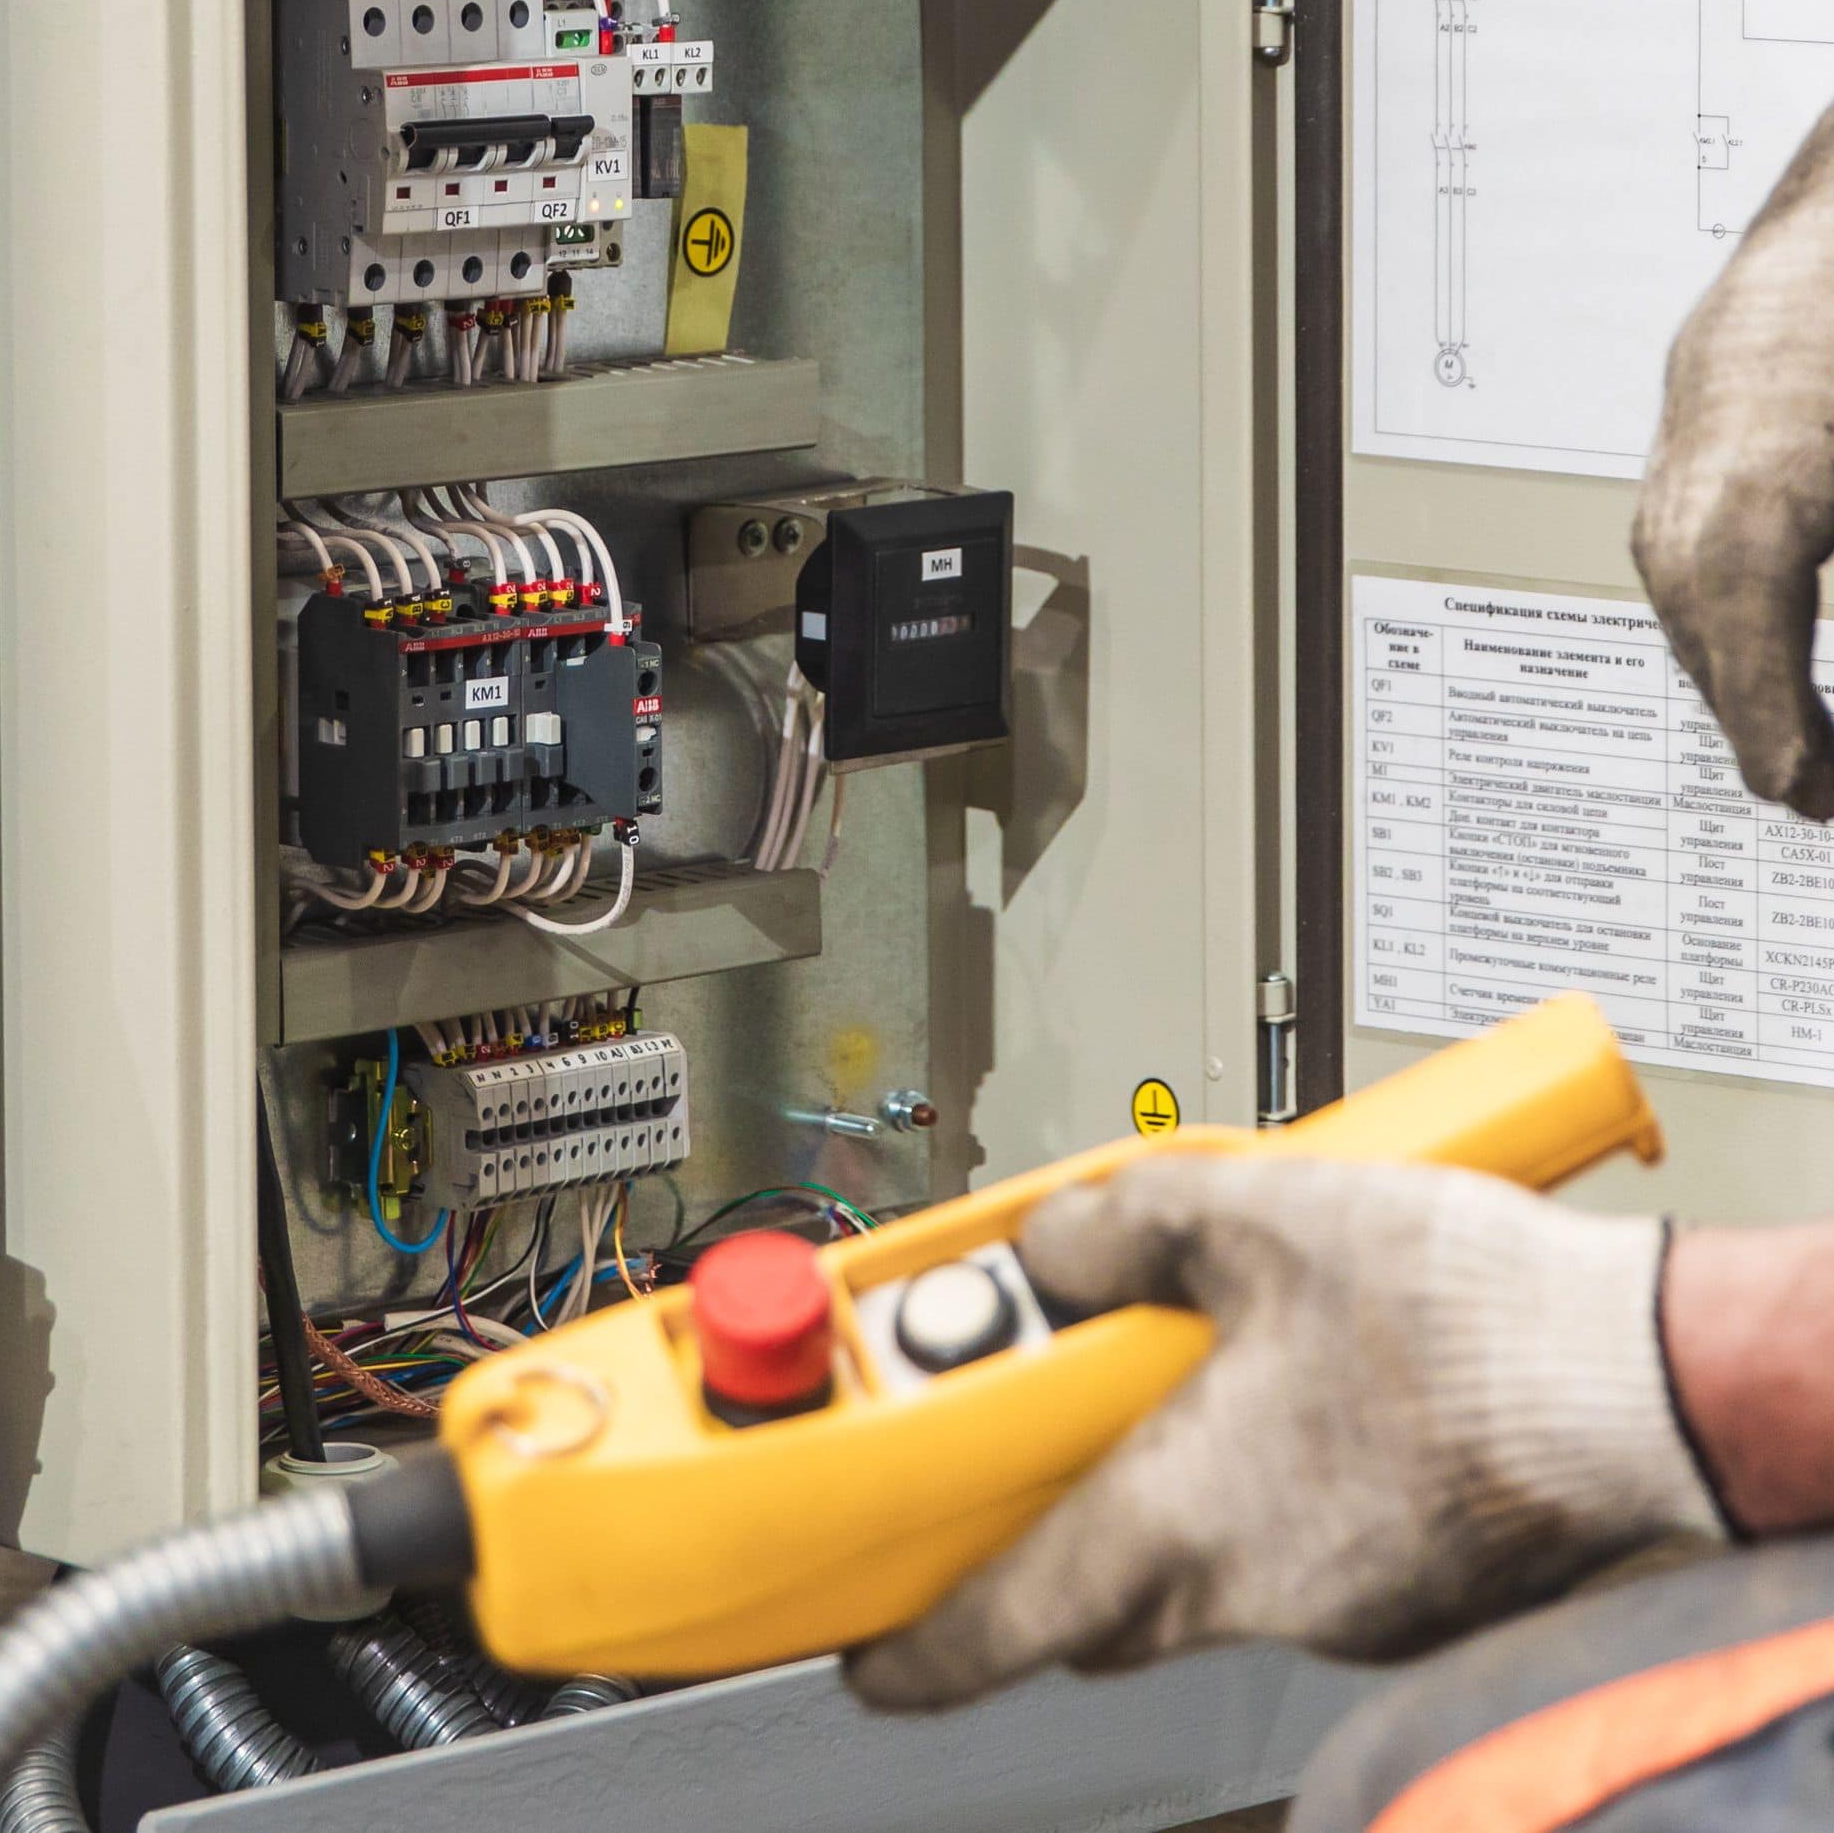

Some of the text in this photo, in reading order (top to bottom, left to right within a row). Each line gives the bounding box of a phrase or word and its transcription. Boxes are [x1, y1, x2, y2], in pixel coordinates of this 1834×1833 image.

[642, 48, 659, 60] KL1
[684, 47, 701, 59] KL2
[595, 159, 620, 174] KV1
[445, 211, 471, 226] QF1
[542, 202, 568, 218] QF2
[931, 558, 953, 572] MH
[1444, 597, 1542, 619] Спецификация
[1546, 610, 1587, 623] схемы
[528, 627, 548, 638] ABB
[1374, 622, 1434, 639] Обозначе-
[405, 643, 426, 653] ABB
[1464, 638, 1552, 659] Наименование
[1556, 651, 1611, 666] элемента
[1626, 657, 1645, 669] его
[1520, 663, 1588, 679] назначение
[471, 685, 502, 702] KM1
[637, 699, 660, 713] ABB
[1449, 687, 1657, 719] Вводный автоматический выключатель
[1449, 711, 1536, 730] Автоматический
[1680, 783, 1743, 799] управления
[1673, 796, 1752, 816] Маслостанция
[1680, 836, 1744, 852] управления
[1698, 855, 1725, 870] Пост
[1781, 846, 1831, 864] CA5X-01
[1680, 871, 1744, 888] управления
[1698, 895, 1725, 910] Пост
[1680, 911, 1744, 928] управления
[1682, 933, 1742, 951] Основание
[1680, 986, 1744, 1004] управления
[1680, 1022, 1744, 1040] управления
[1791, 1025, 1822, 1042] HM-1
[1674, 1035, 1752, 1057] Маслостанция
